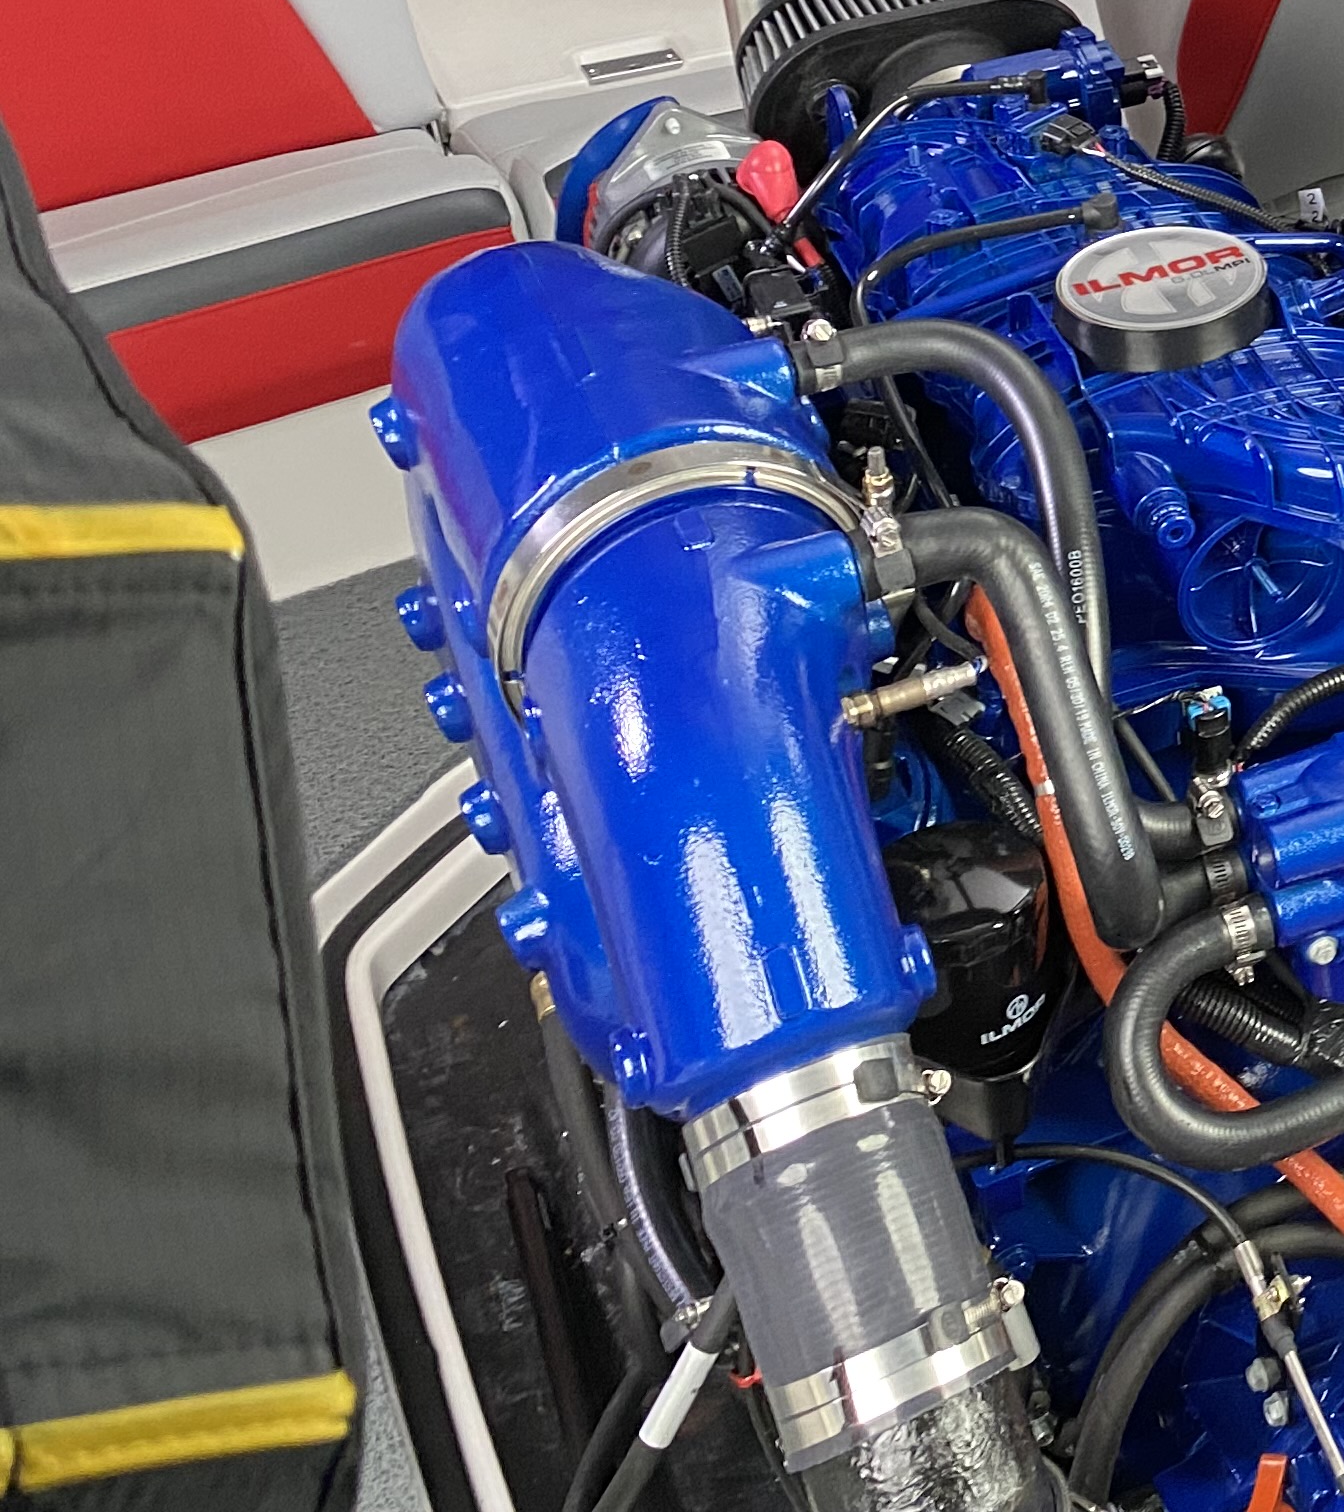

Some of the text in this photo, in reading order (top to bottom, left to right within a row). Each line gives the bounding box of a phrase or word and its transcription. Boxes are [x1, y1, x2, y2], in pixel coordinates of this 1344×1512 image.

[1306, 192, 1318, 205] 2
[1072, 246, 1245, 296] ILMOR
[1086, 747, 1101, 762] IN
[980, 992, 1046, 1046] ILMOR
